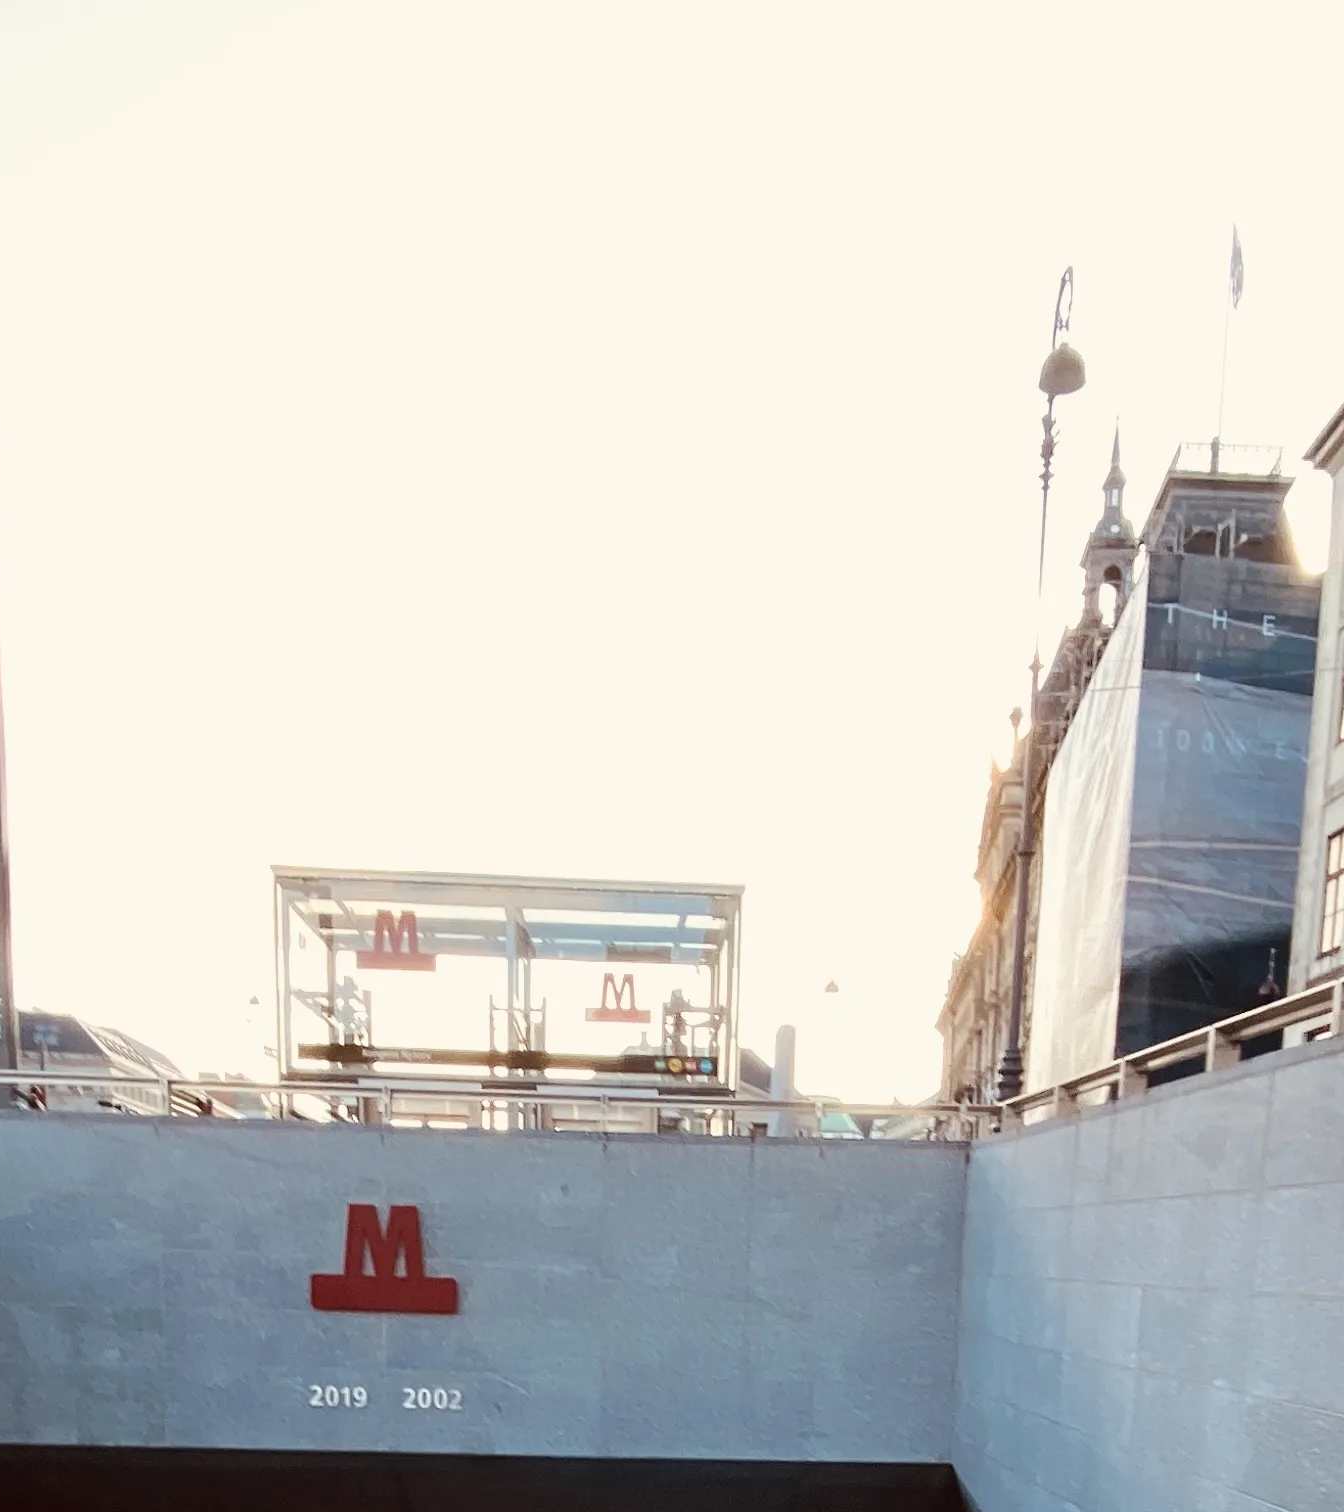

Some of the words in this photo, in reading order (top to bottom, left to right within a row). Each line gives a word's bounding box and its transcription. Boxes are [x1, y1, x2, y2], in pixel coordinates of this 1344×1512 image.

[1164, 602, 1277, 637] THE
[308, 1385, 368, 1408] 2019
[402, 1387, 463, 1410] 2002
